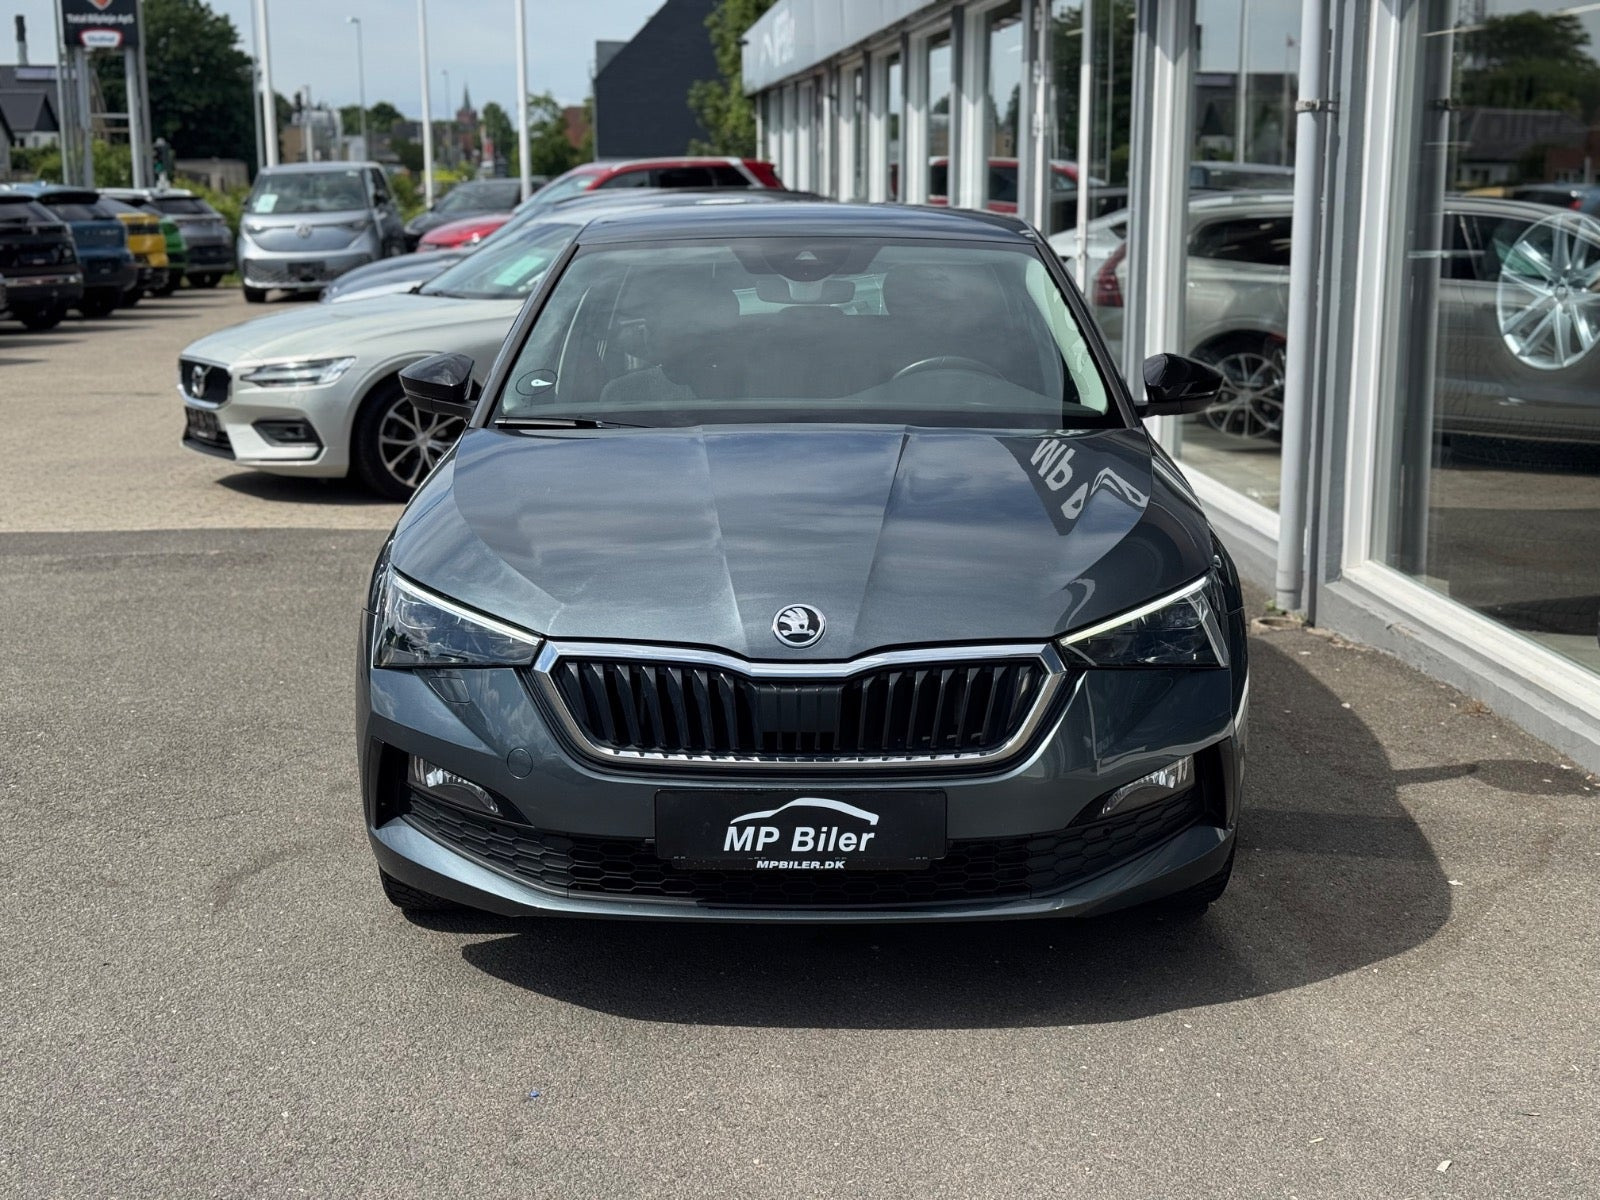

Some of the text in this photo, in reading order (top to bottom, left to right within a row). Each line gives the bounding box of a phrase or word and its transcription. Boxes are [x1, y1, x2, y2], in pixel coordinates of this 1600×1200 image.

[723, 826, 875, 852] MP Biler
[756, 860, 846, 869] MPBILER.DK
